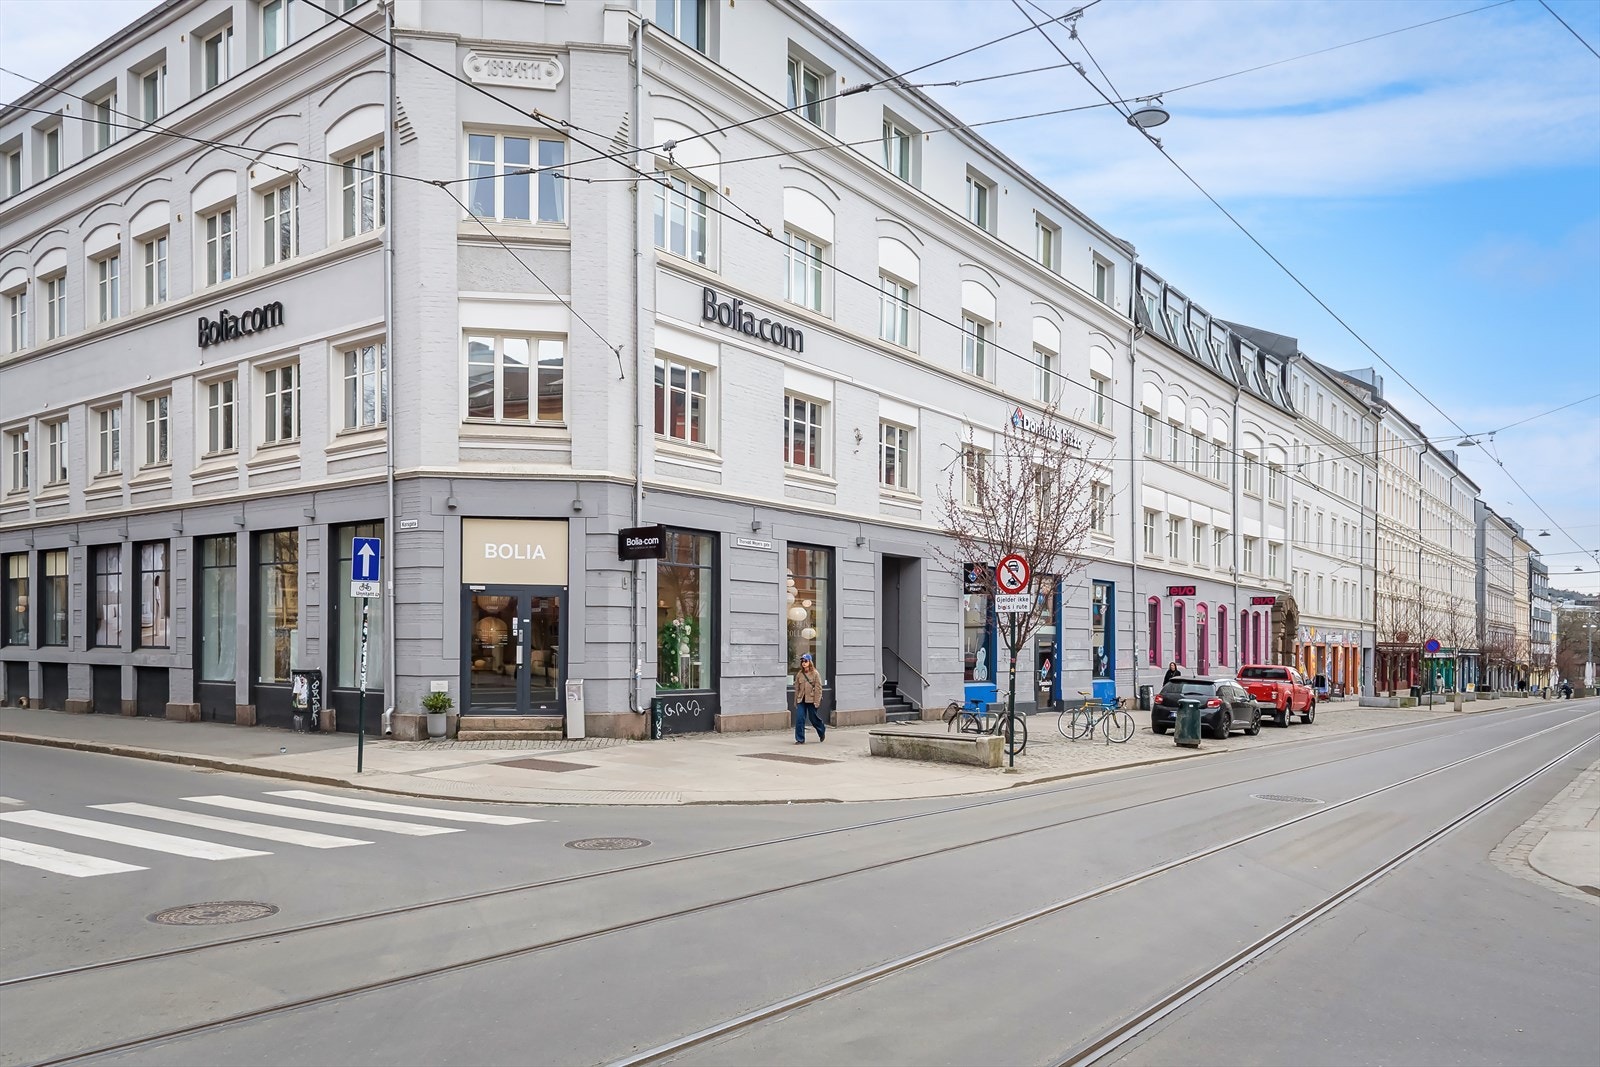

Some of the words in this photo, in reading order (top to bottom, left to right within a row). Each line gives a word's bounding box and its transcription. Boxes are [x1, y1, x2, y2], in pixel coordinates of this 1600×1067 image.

[198, 301, 284, 347] Bolia.com
[704, 286, 804, 353] Bolia.com
[626, 537, 659, 546] Bolia.com
[485, 543, 546, 559] BOLIA
[1170, 587, 1194, 595] evo
